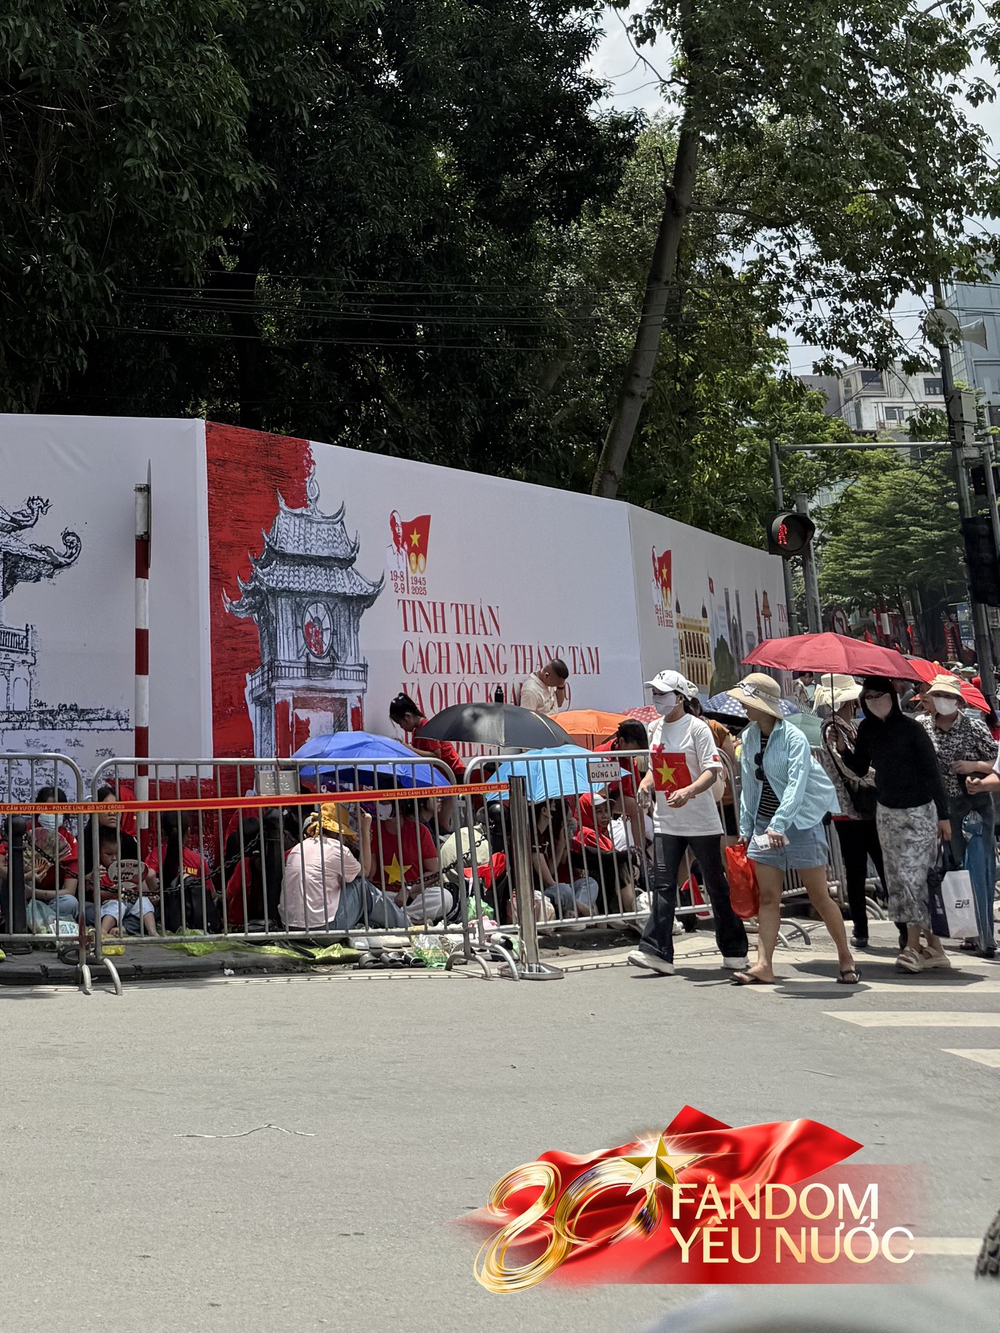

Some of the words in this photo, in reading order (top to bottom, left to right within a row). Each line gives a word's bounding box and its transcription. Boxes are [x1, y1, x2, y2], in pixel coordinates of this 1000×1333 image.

[390, 570, 405, 582] 19-8
[411, 576, 427, 586] 1945
[394, 582, 406, 594] 2-9
[411, 586, 427, 596] 2025
[397, 598, 448, 634] TINH
